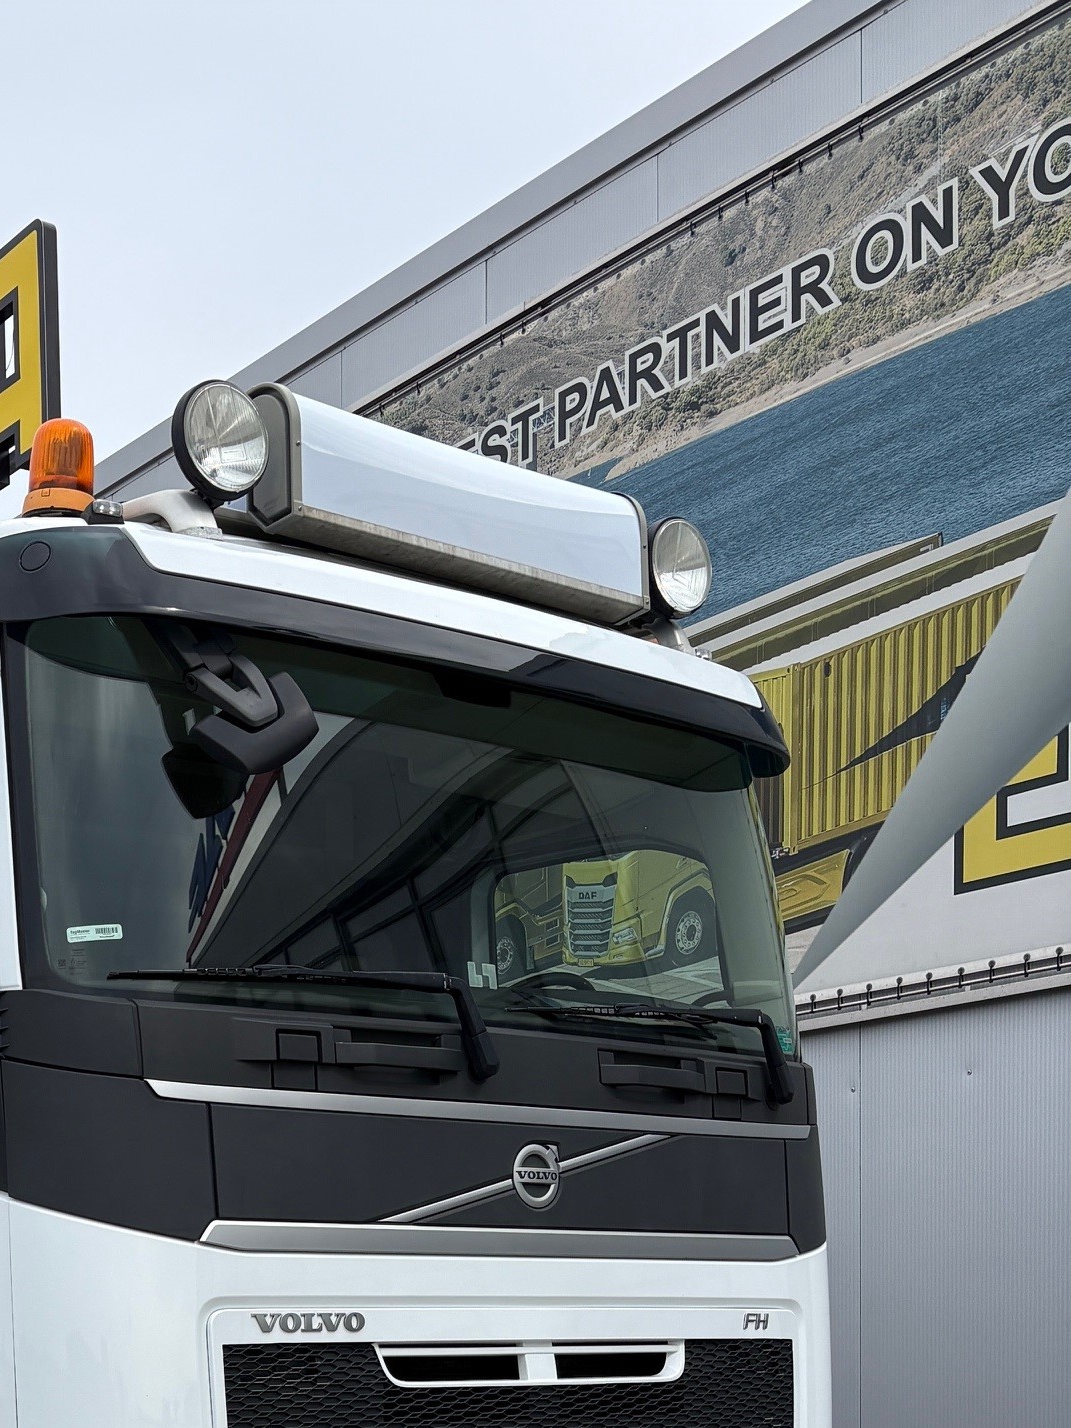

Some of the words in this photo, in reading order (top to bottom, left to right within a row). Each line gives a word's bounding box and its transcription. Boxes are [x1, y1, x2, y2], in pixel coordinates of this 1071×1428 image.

[458, 402, 542, 464] ST
[557, 252, 835, 445] PARTNER
[855, 184, 955, 285] ON
[579, 891, 597, 900] DAF
[516, 1170, 558, 1181] VOLVO
[251, 1312, 366, 1334] VOLVO
[743, 1312, 770, 1331] FH
